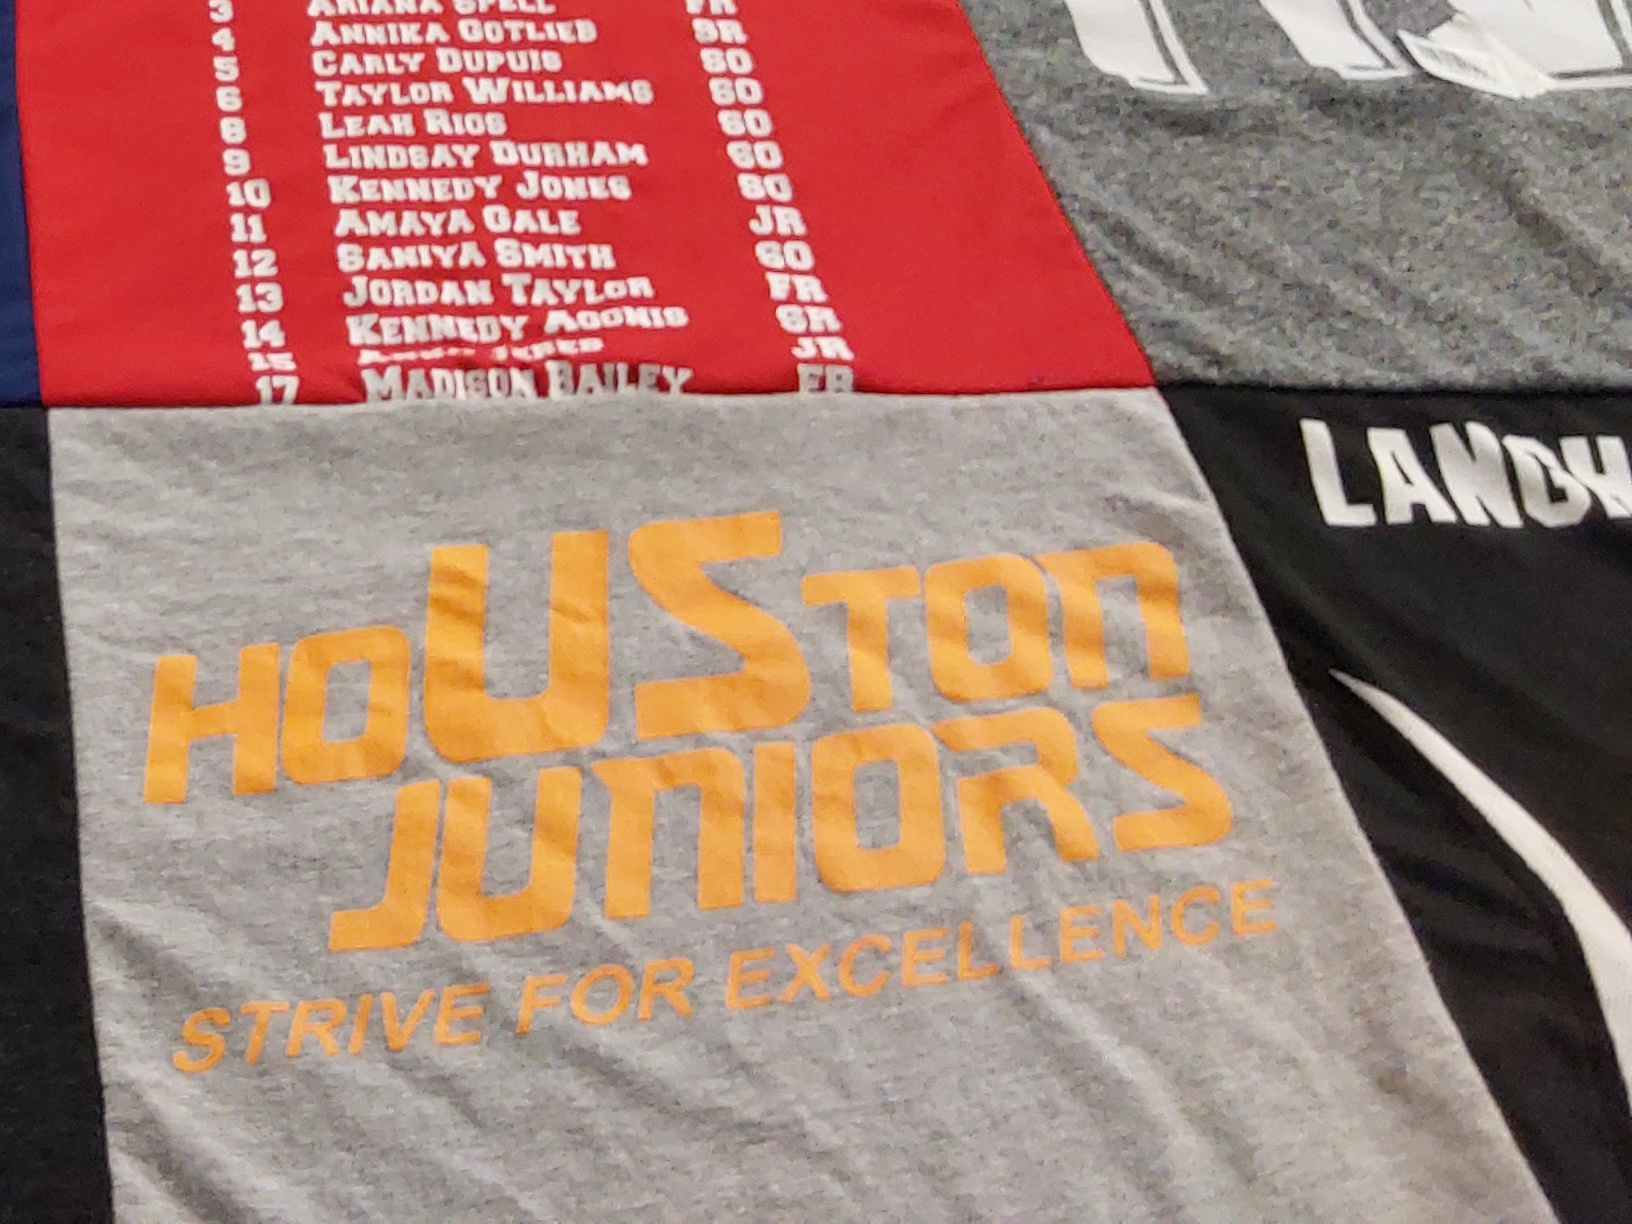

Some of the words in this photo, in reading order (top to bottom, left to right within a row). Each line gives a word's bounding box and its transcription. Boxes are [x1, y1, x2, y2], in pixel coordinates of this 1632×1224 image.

[211, 28, 235, 52] 4
[213, 56, 239, 82] 5
[215, 86, 243, 112] 6
[222, 148, 251, 175] 9
[226, 178, 271, 208] 10
[230, 213, 267, 243] 11
[233, 249, 278, 278] 12
[235, 282, 284, 313] 13
[241, 320, 286, 349] 14
[255, 375, 300, 405] 17
[143, 510, 1190, 804] HOUSTON
[328, 694, 1233, 951] JUNIORS
[171, 982, 492, 1073] STRIVE
[514, 953, 696, 1035] FOR
[723, 876, 1282, 1012] EXCELLENCE
